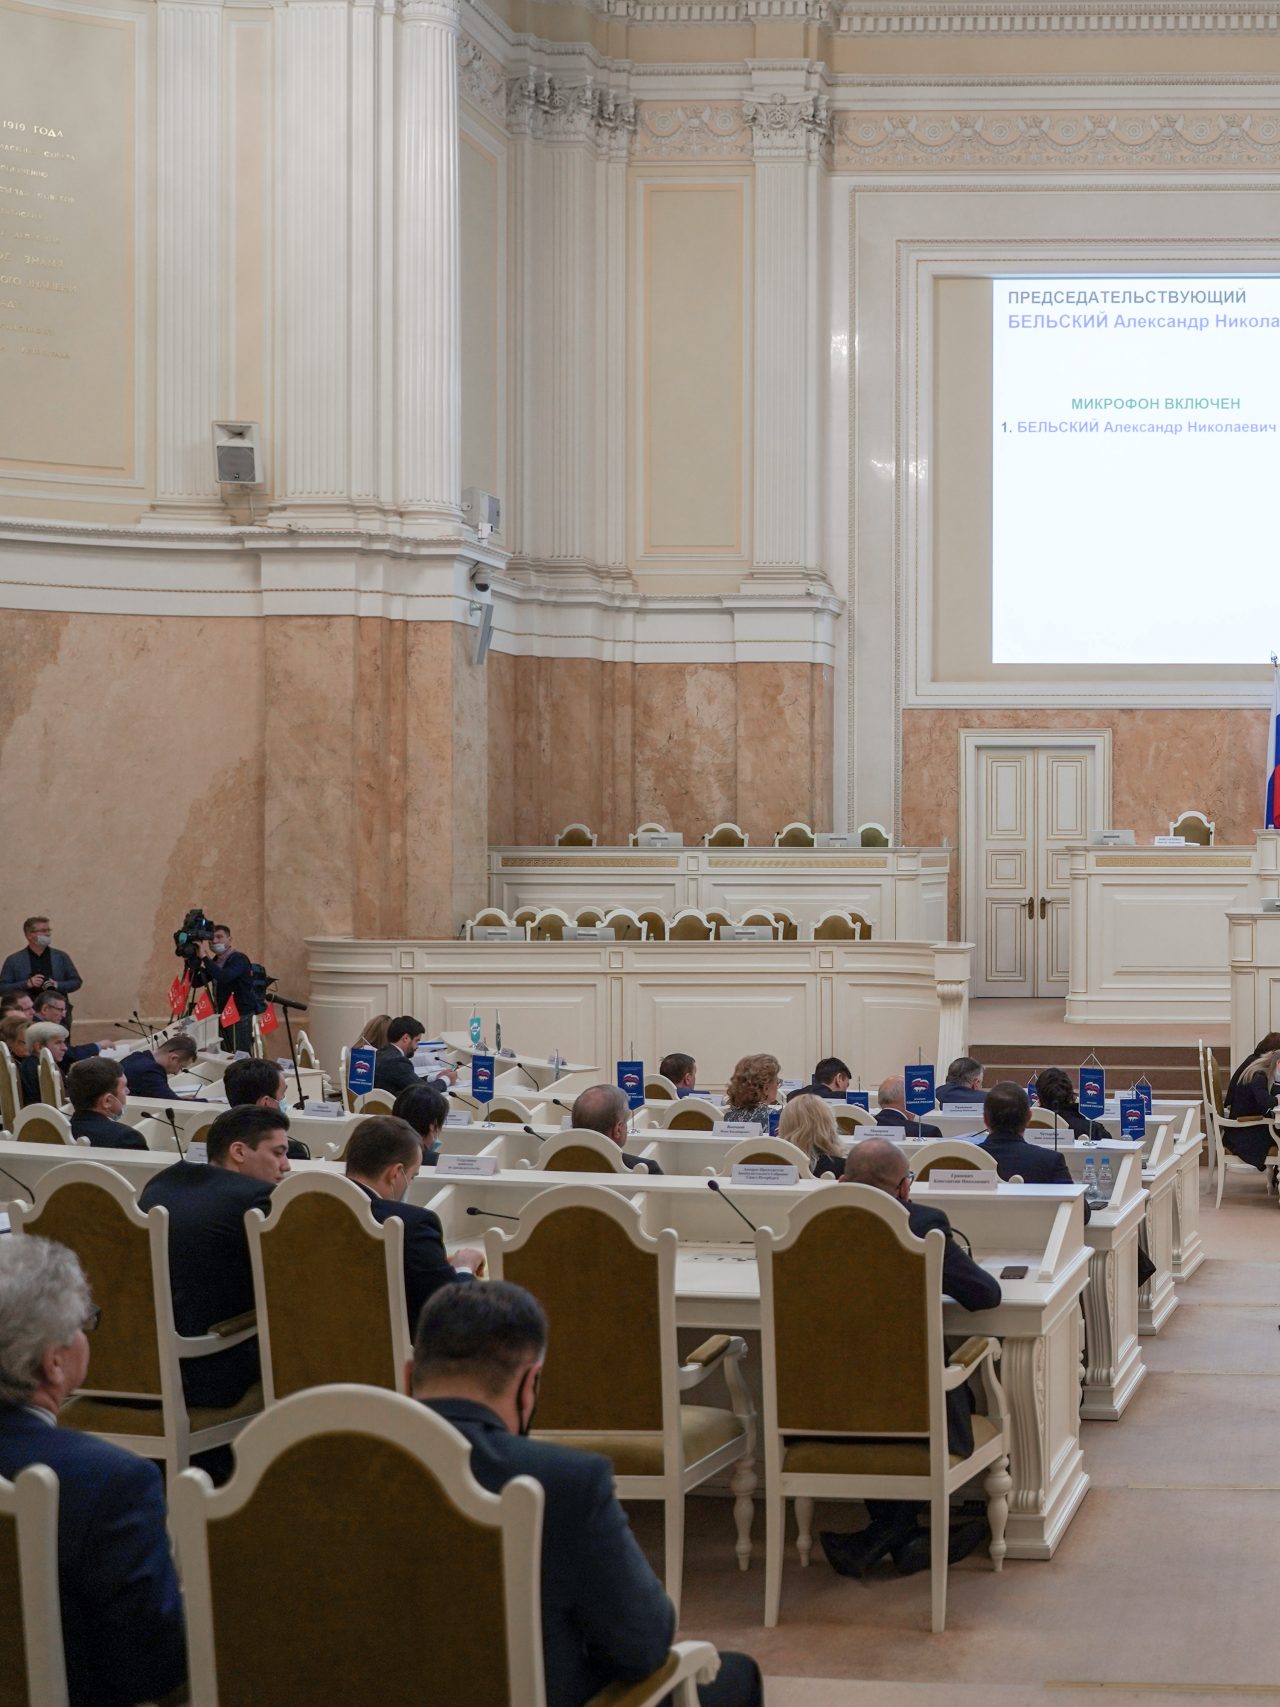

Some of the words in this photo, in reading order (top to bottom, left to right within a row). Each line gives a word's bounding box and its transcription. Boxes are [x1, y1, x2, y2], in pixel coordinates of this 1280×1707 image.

[1008, 287, 1247, 307] ПРЕДСЕДАТЕЛЬСТВУЮЩИЙ
[1008, 311, 1108, 329] БЕЛЬСКИЙ
[1113, 314, 1210, 332] Александр
[1071, 397, 1161, 411] МИКРОФОН
[1164, 397, 1241, 411] ВКЛЮЧЕН
[1001, 421, 1013, 433] 1.
[1017, 418, 1099, 433] БЕЛЬСКИЙ
[1103, 421, 1183, 436] Александр
[1187, 420, 1277, 433] Николаевич
